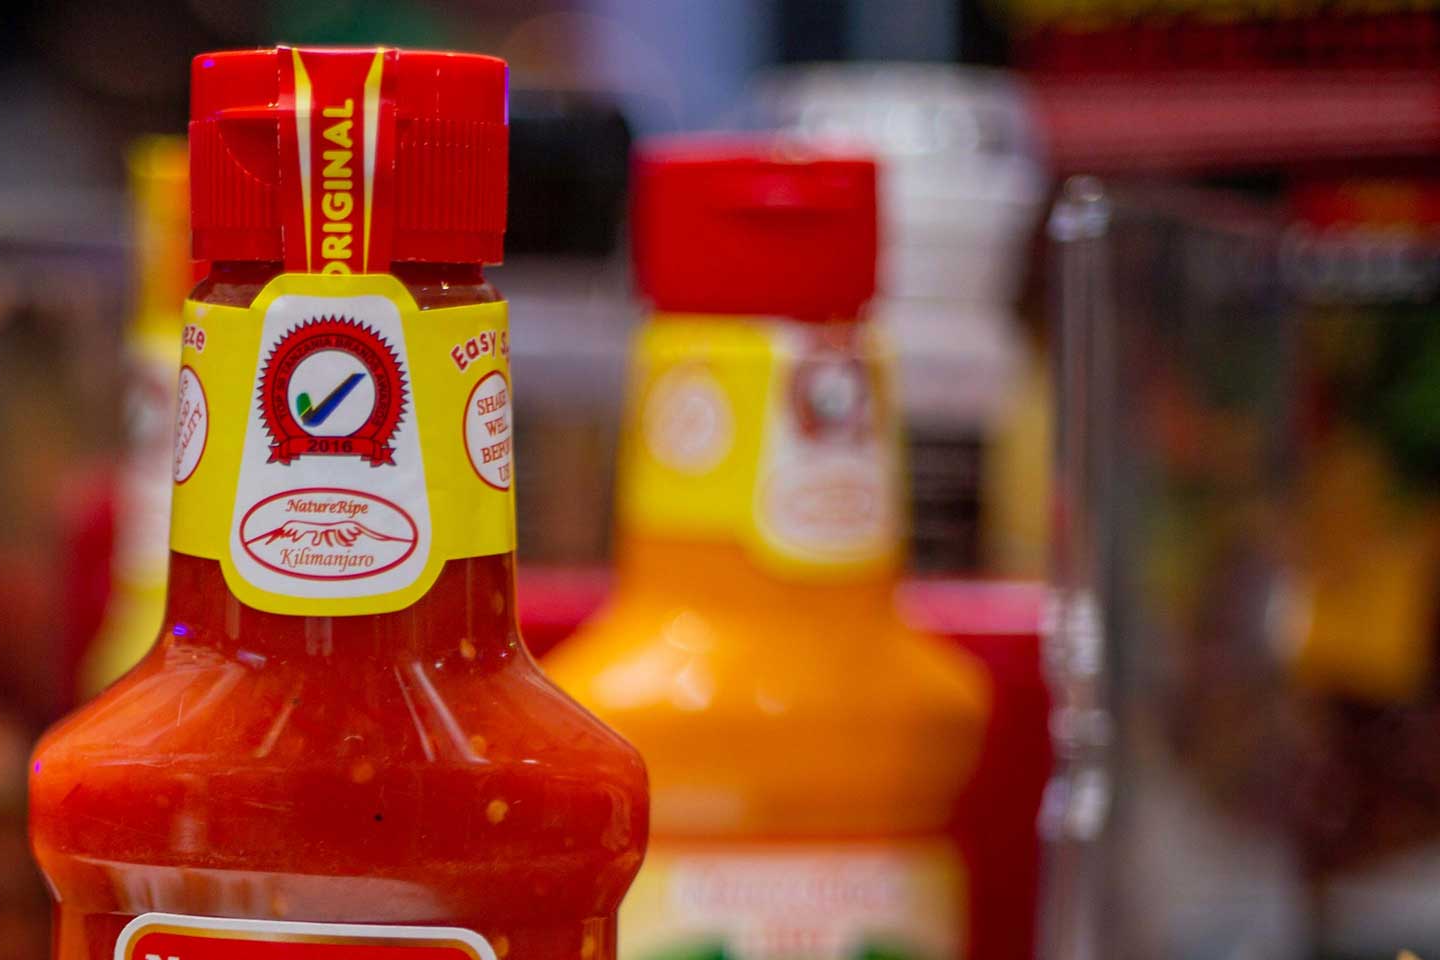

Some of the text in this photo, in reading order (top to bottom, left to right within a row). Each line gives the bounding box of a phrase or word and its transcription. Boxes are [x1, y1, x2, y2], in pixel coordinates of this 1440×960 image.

[451, 331, 496, 371] Easy
[307, 439, 353, 453] 2016
[285, 499, 368, 518] NatureRipe
[280, 547, 374, 572] Kilimanjaro
